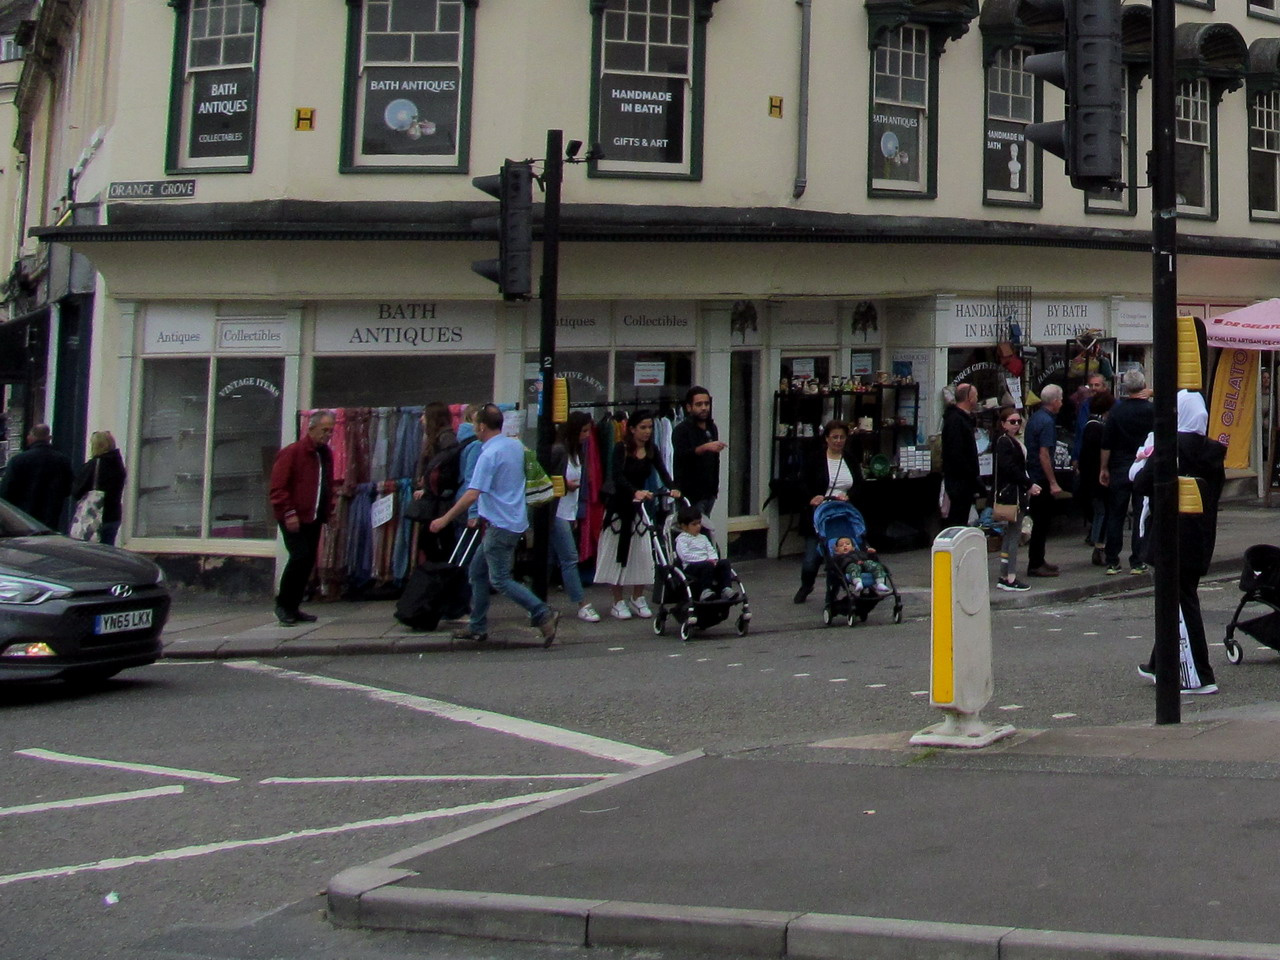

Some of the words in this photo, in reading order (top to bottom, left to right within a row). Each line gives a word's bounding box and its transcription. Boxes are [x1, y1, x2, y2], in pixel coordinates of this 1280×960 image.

[210, 83, 237, 96] BATH
[371, 80, 399, 90] BATH
[401, 80, 456, 92] ANTIQUES
[611, 89, 672, 101] HANDMADE
[199, 99, 248, 116] ANTIQUES
[621, 103, 632, 113] IN
[634, 104, 662, 114] BATH
[296, 109, 314, 130] H
[889, 116, 918, 128] ANTIQUES
[199, 132, 242, 142] COLLECTABLES
[613, 137, 640, 147] GIFTS
[641, 138, 648, 147] &
[650, 139, 668, 148] ART
[111, 184, 155, 196] ORANGE
[160, 182, 193, 195] GROVE
[377, 304, 437, 319] BATH
[1047, 305, 1061, 317] BY
[1063, 305, 1088, 318] BATH
[623, 314, 688, 327] Collectibles
[157, 330, 201, 343] Antiques
[223, 329, 282, 342] Collectibles
[349, 327, 463, 346] ANTIQUES
[965, 324, 978, 337] IN
[543, 356, 552, 367] 2
[951, 366, 972, 385] NIQUE
[219, 377, 255, 397] VINTAGE
[256, 378, 281, 398] ITEMS
[1221, 349, 1248, 426] GELATO
[103, 614, 130, 631] YN65
[132, 610, 152, 627] LKX
